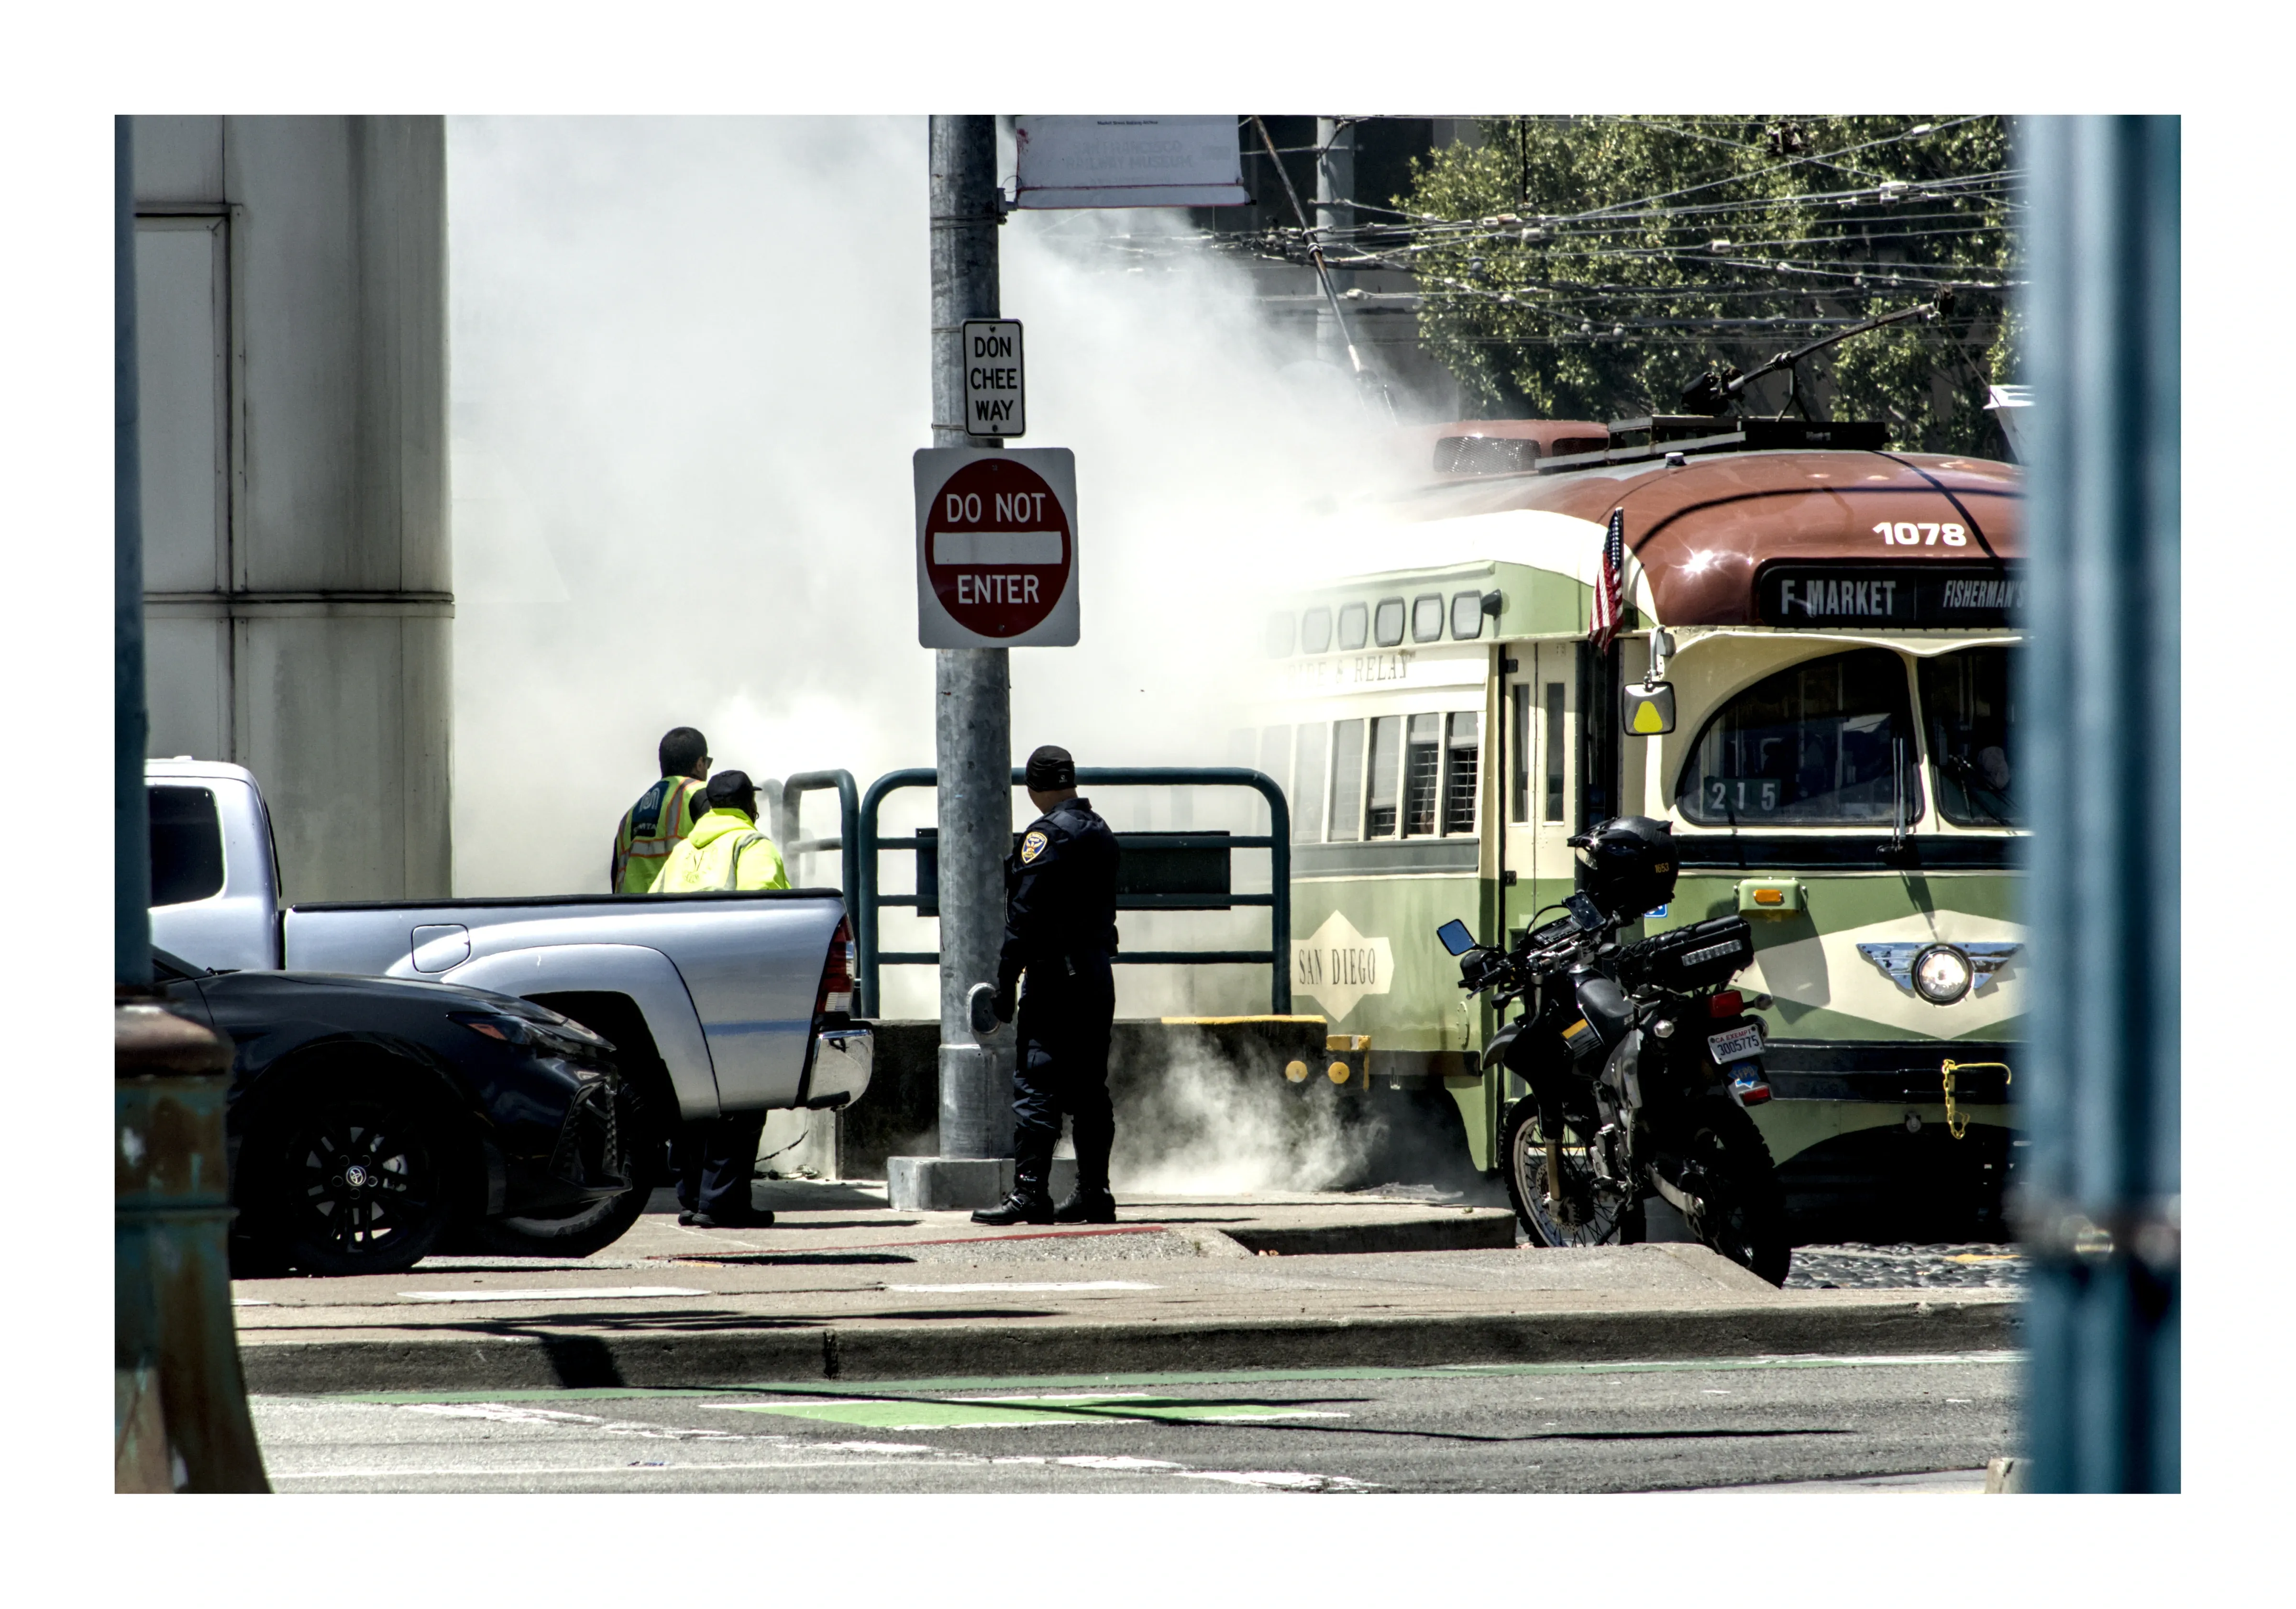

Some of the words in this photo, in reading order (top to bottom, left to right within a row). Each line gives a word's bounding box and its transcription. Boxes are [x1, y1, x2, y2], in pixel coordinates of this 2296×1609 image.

[974, 336, 1012, 358] DON
[970, 367, 1018, 390] CHEE
[975, 399, 1014, 421] WAY
[946, 492, 982, 523] DO
[995, 492, 1046, 523] NOT
[1872, 522, 1967, 547] 1078
[957, 574, 1040, 604] ENTER
[1781, 579, 1796, 615] F
[1806, 579, 1897, 615] MARKET
[1655, 862, 1670, 874] 1653
[1299, 948, 1323, 985] SAN
[1332, 947, 1376, 985] DIEGO
[1717, 1034, 1760, 1056] 3005775
[1726, 1029, 1752, 1041] EXEMPT
[1733, 1065, 1755, 1079] SFPD
